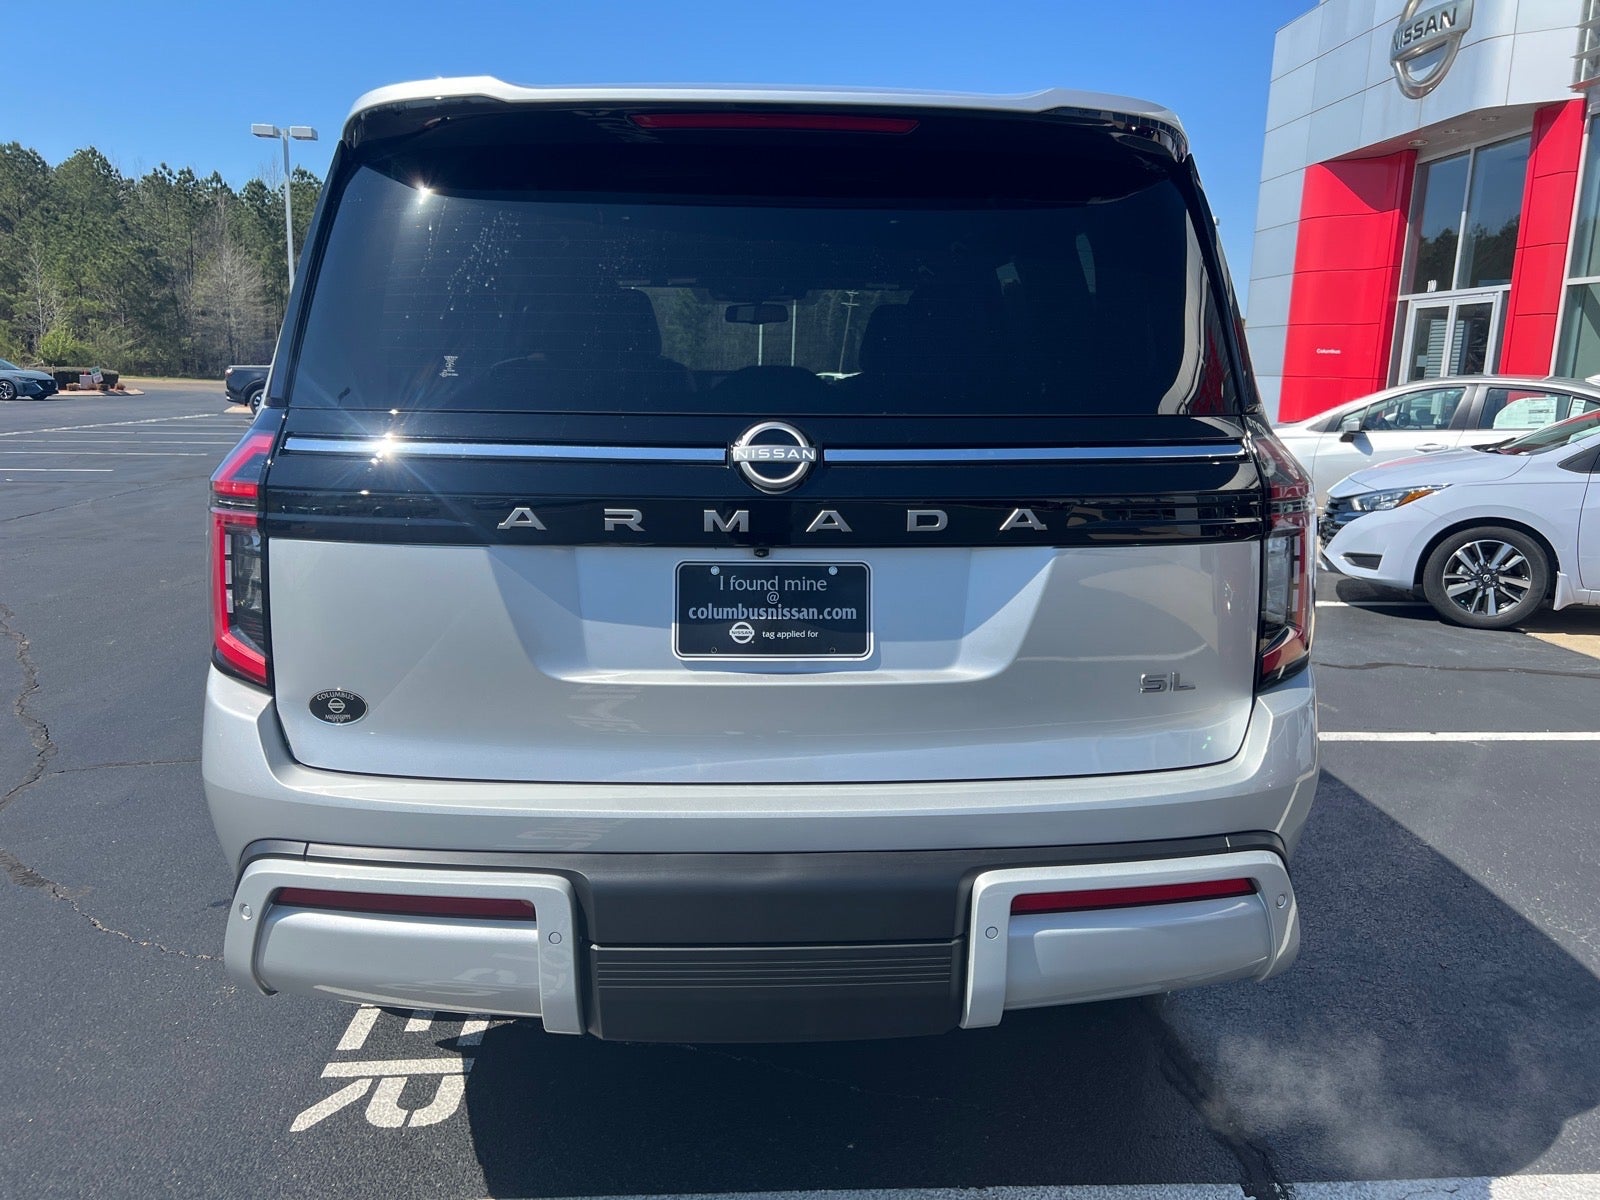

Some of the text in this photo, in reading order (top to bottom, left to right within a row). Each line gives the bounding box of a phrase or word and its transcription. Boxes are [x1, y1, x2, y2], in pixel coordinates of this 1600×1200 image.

[1393, 7, 1457, 51] NISSAN
[735, 448, 815, 460] NISSAN
[497, 507, 1048, 532] ARMADA
[729, 575, 779, 591] found
[784, 576, 828, 591] mine
[766, 591, 780, 605] @
[688, 603, 857, 620] columbusnissan.com
[762, 630, 819, 640] tag applied for
[1140, 672, 1196, 693] SL
[316, 691, 355, 701] COLUMBUS
